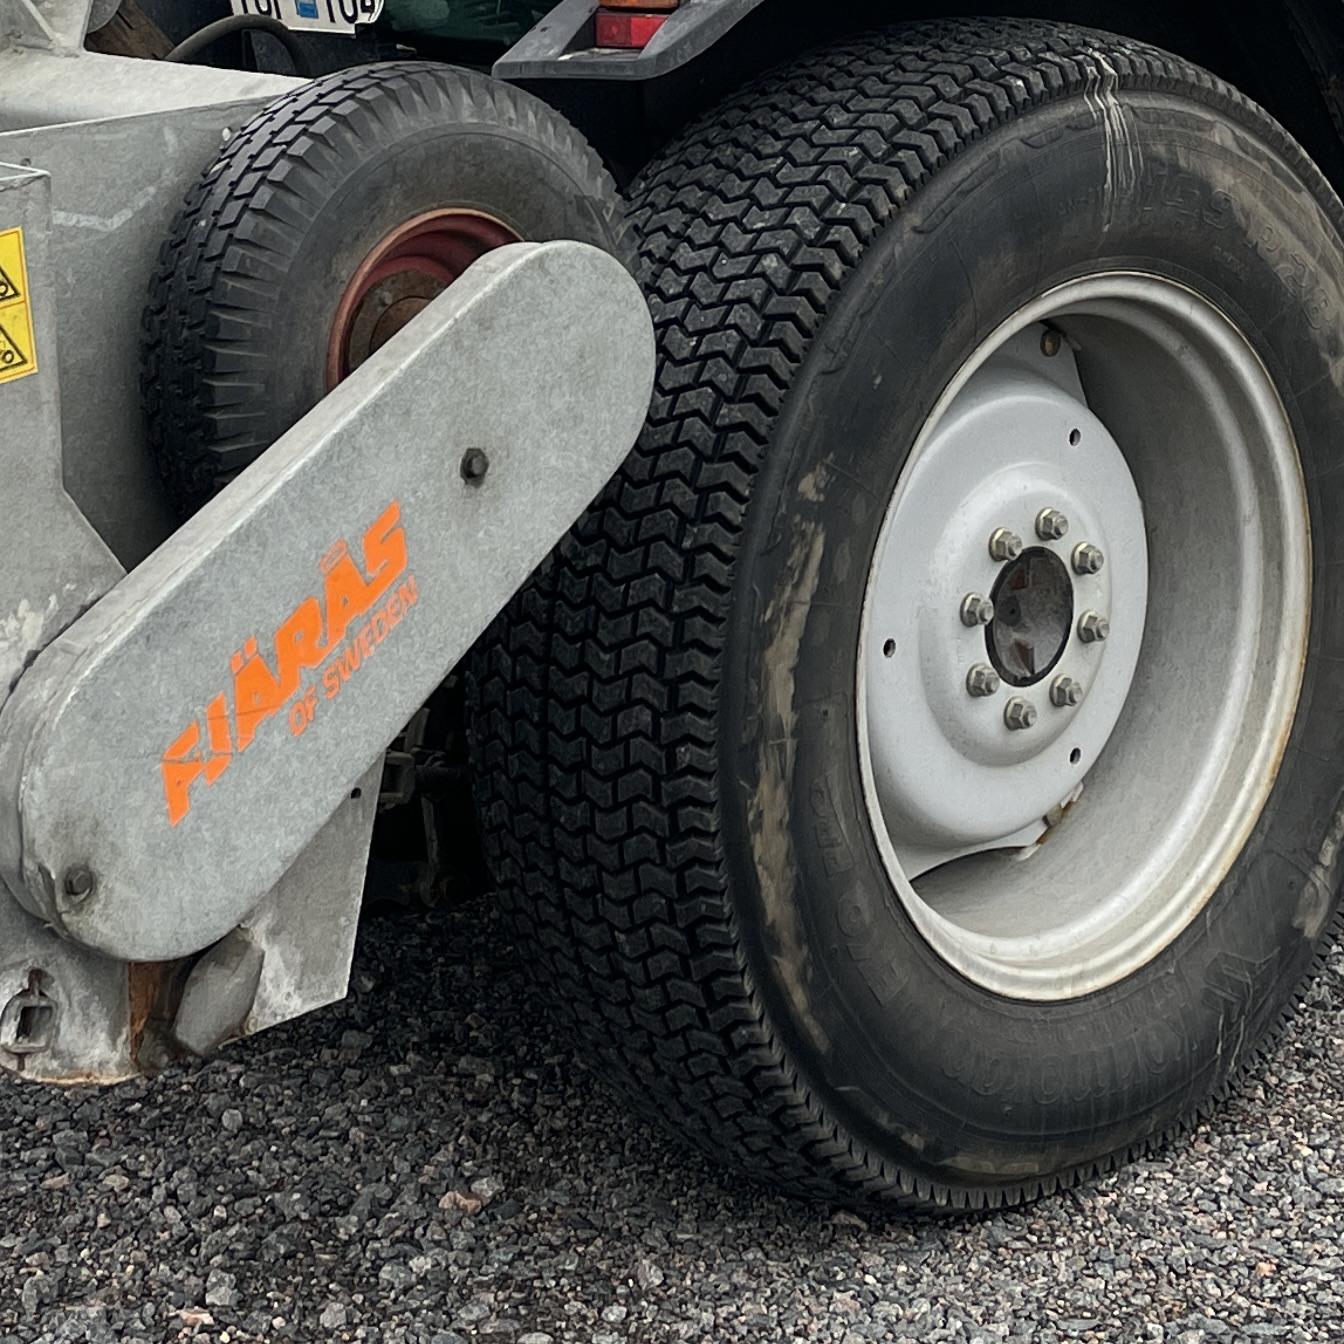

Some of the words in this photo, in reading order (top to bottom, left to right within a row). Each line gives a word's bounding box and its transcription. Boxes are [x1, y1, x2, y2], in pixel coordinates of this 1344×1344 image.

[161, 497, 408, 829] FJÄRÅS
[288, 686, 319, 737] OF
[322, 574, 419, 700] SWEDEN
